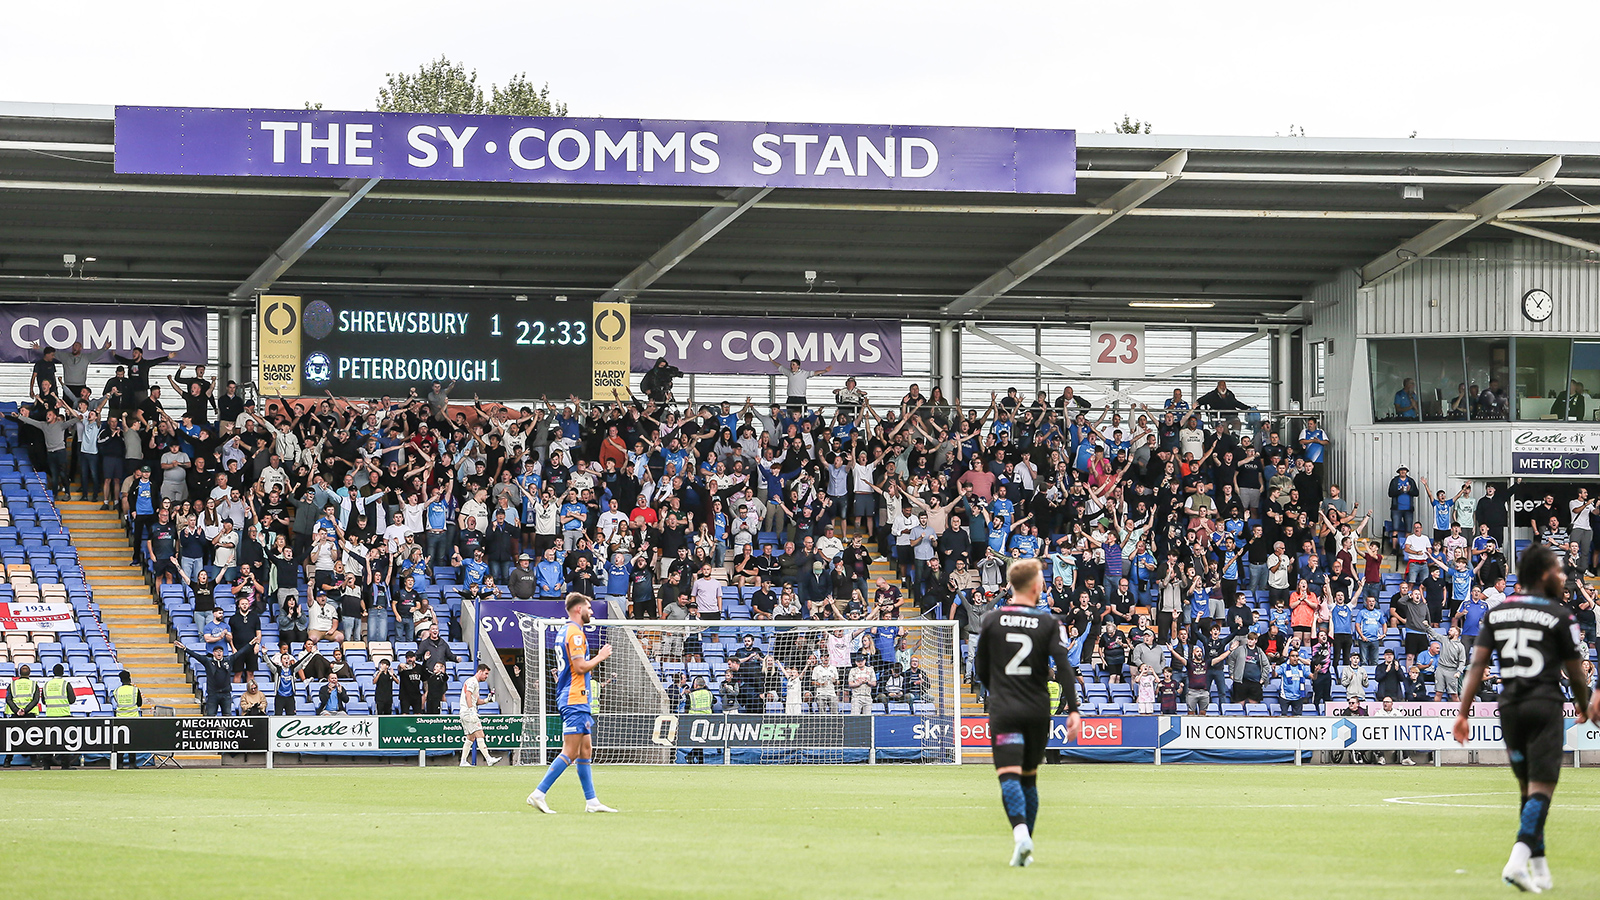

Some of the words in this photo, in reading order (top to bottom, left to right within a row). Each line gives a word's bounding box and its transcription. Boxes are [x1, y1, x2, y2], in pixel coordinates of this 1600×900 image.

[260, 121, 373, 166] THE
[752, 133, 939, 178] STAND
[338, 310, 469, 334] SHREWSBURY
[490, 313, 502, 336] 1
[516, 320, 587, 345] 22:33
[1097, 333, 1139, 364] 23
[263, 364, 296, 373] HARDY
[338, 357, 486, 382] PETERBOROUGH
[490, 358, 501, 382] 1
[594, 370, 626, 379] HARDY
[1515, 431, 1567, 445] Castle
[1564, 459, 1589, 469] ROD
[25, 605, 52, 613] 1934
[28, 614, 67, 622] UNITED
[1000, 614, 1040, 629] CURTIS
[1004, 632, 1034, 676] 2
[1493, 627, 1545, 679] 35
[1439, 706, 1475, 717] crod
[182, 719, 254, 728] MECHANICAL
[416, 717, 451, 725] Shropshire's
[505, 716, 535, 724] affordable
[5, 719, 131, 751] penguin
[182, 729, 249, 738] ELECTRICAL
[276, 719, 348, 738] Castle
[913, 720, 950, 744] sky
[1081, 720, 1118, 740] bet
[1186, 725, 1200, 739] IN
[1205, 725, 1327, 740] CONSTRUCTION?
[1362, 726, 1389, 740] GET
[1586, 730, 1600, 740] cr
[182, 740, 239, 749] PLUMBING
